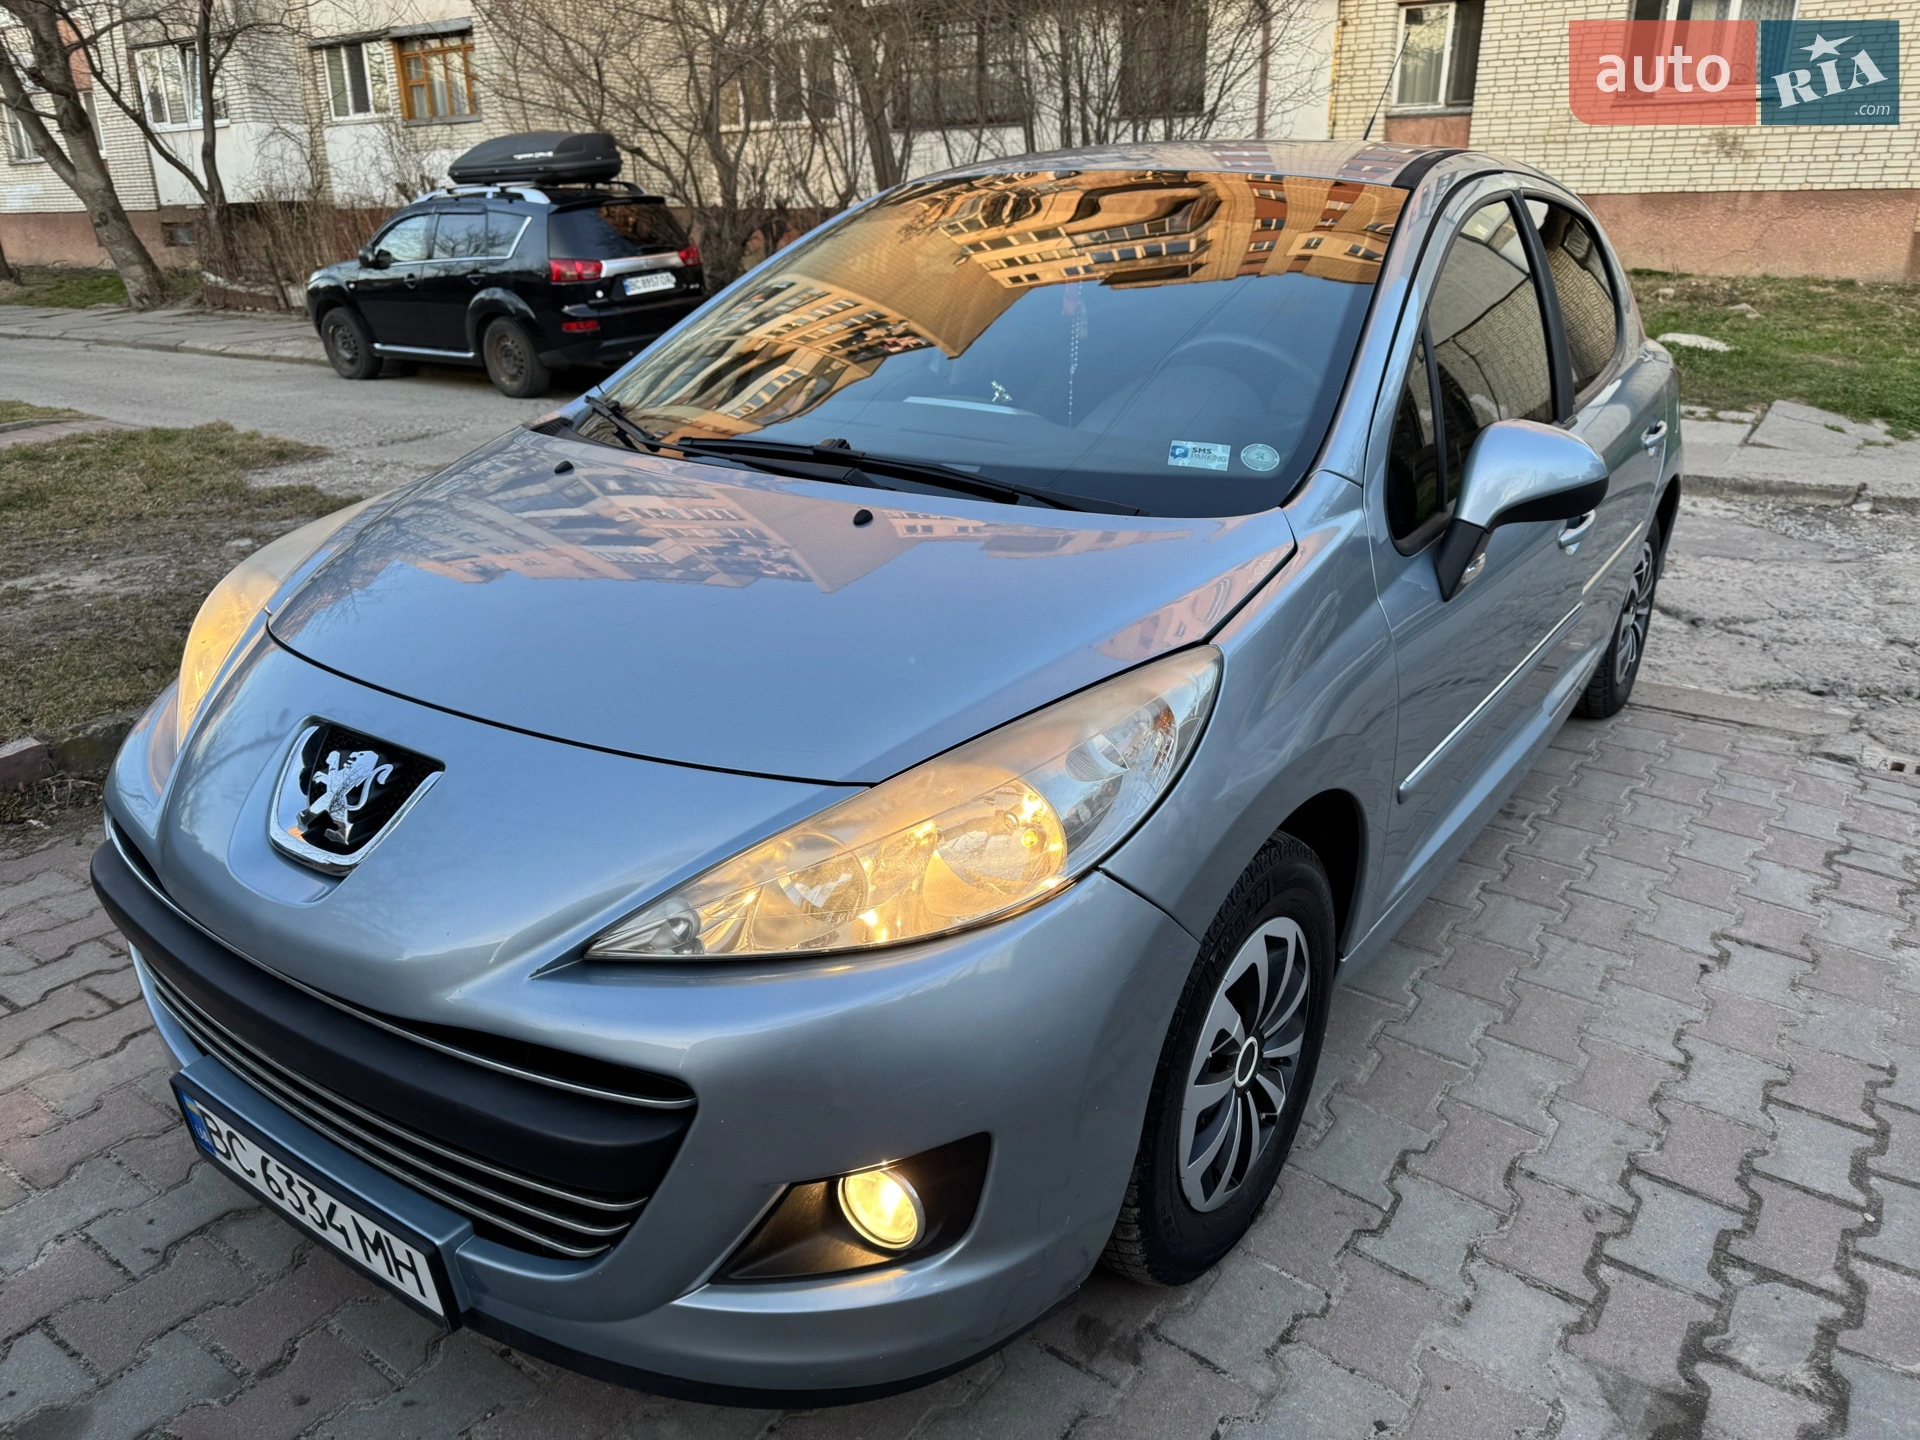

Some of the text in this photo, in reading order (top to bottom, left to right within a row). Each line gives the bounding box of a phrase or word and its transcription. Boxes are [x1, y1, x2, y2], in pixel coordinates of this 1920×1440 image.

[1191, 453, 1228, 463] PARKING
[197, 1107, 427, 1298] BC 6334 MH
